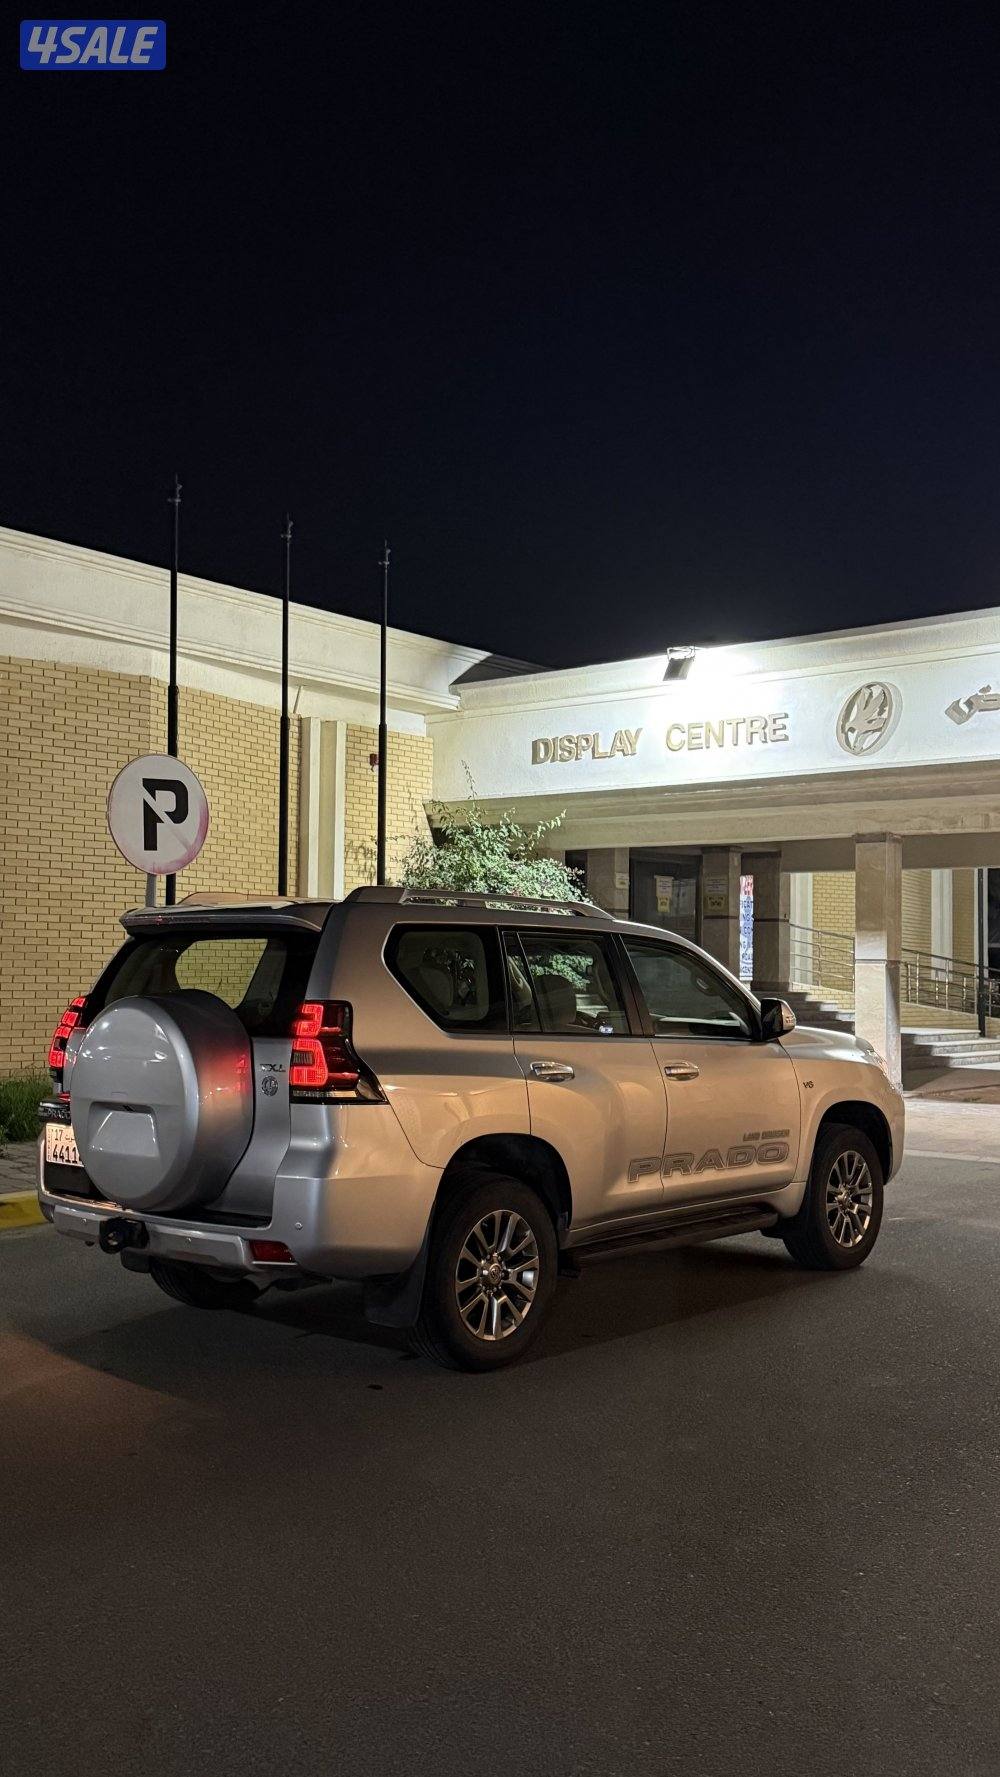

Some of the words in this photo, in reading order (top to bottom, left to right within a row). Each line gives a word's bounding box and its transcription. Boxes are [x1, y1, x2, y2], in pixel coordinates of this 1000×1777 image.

[531, 727, 643, 765] DISPLAY
[665, 712, 789, 751] CENTRE
[142, 777, 189, 851] P
[52, 1144, 81, 1164] 4411
[627, 1141, 790, 1183] PRADO
